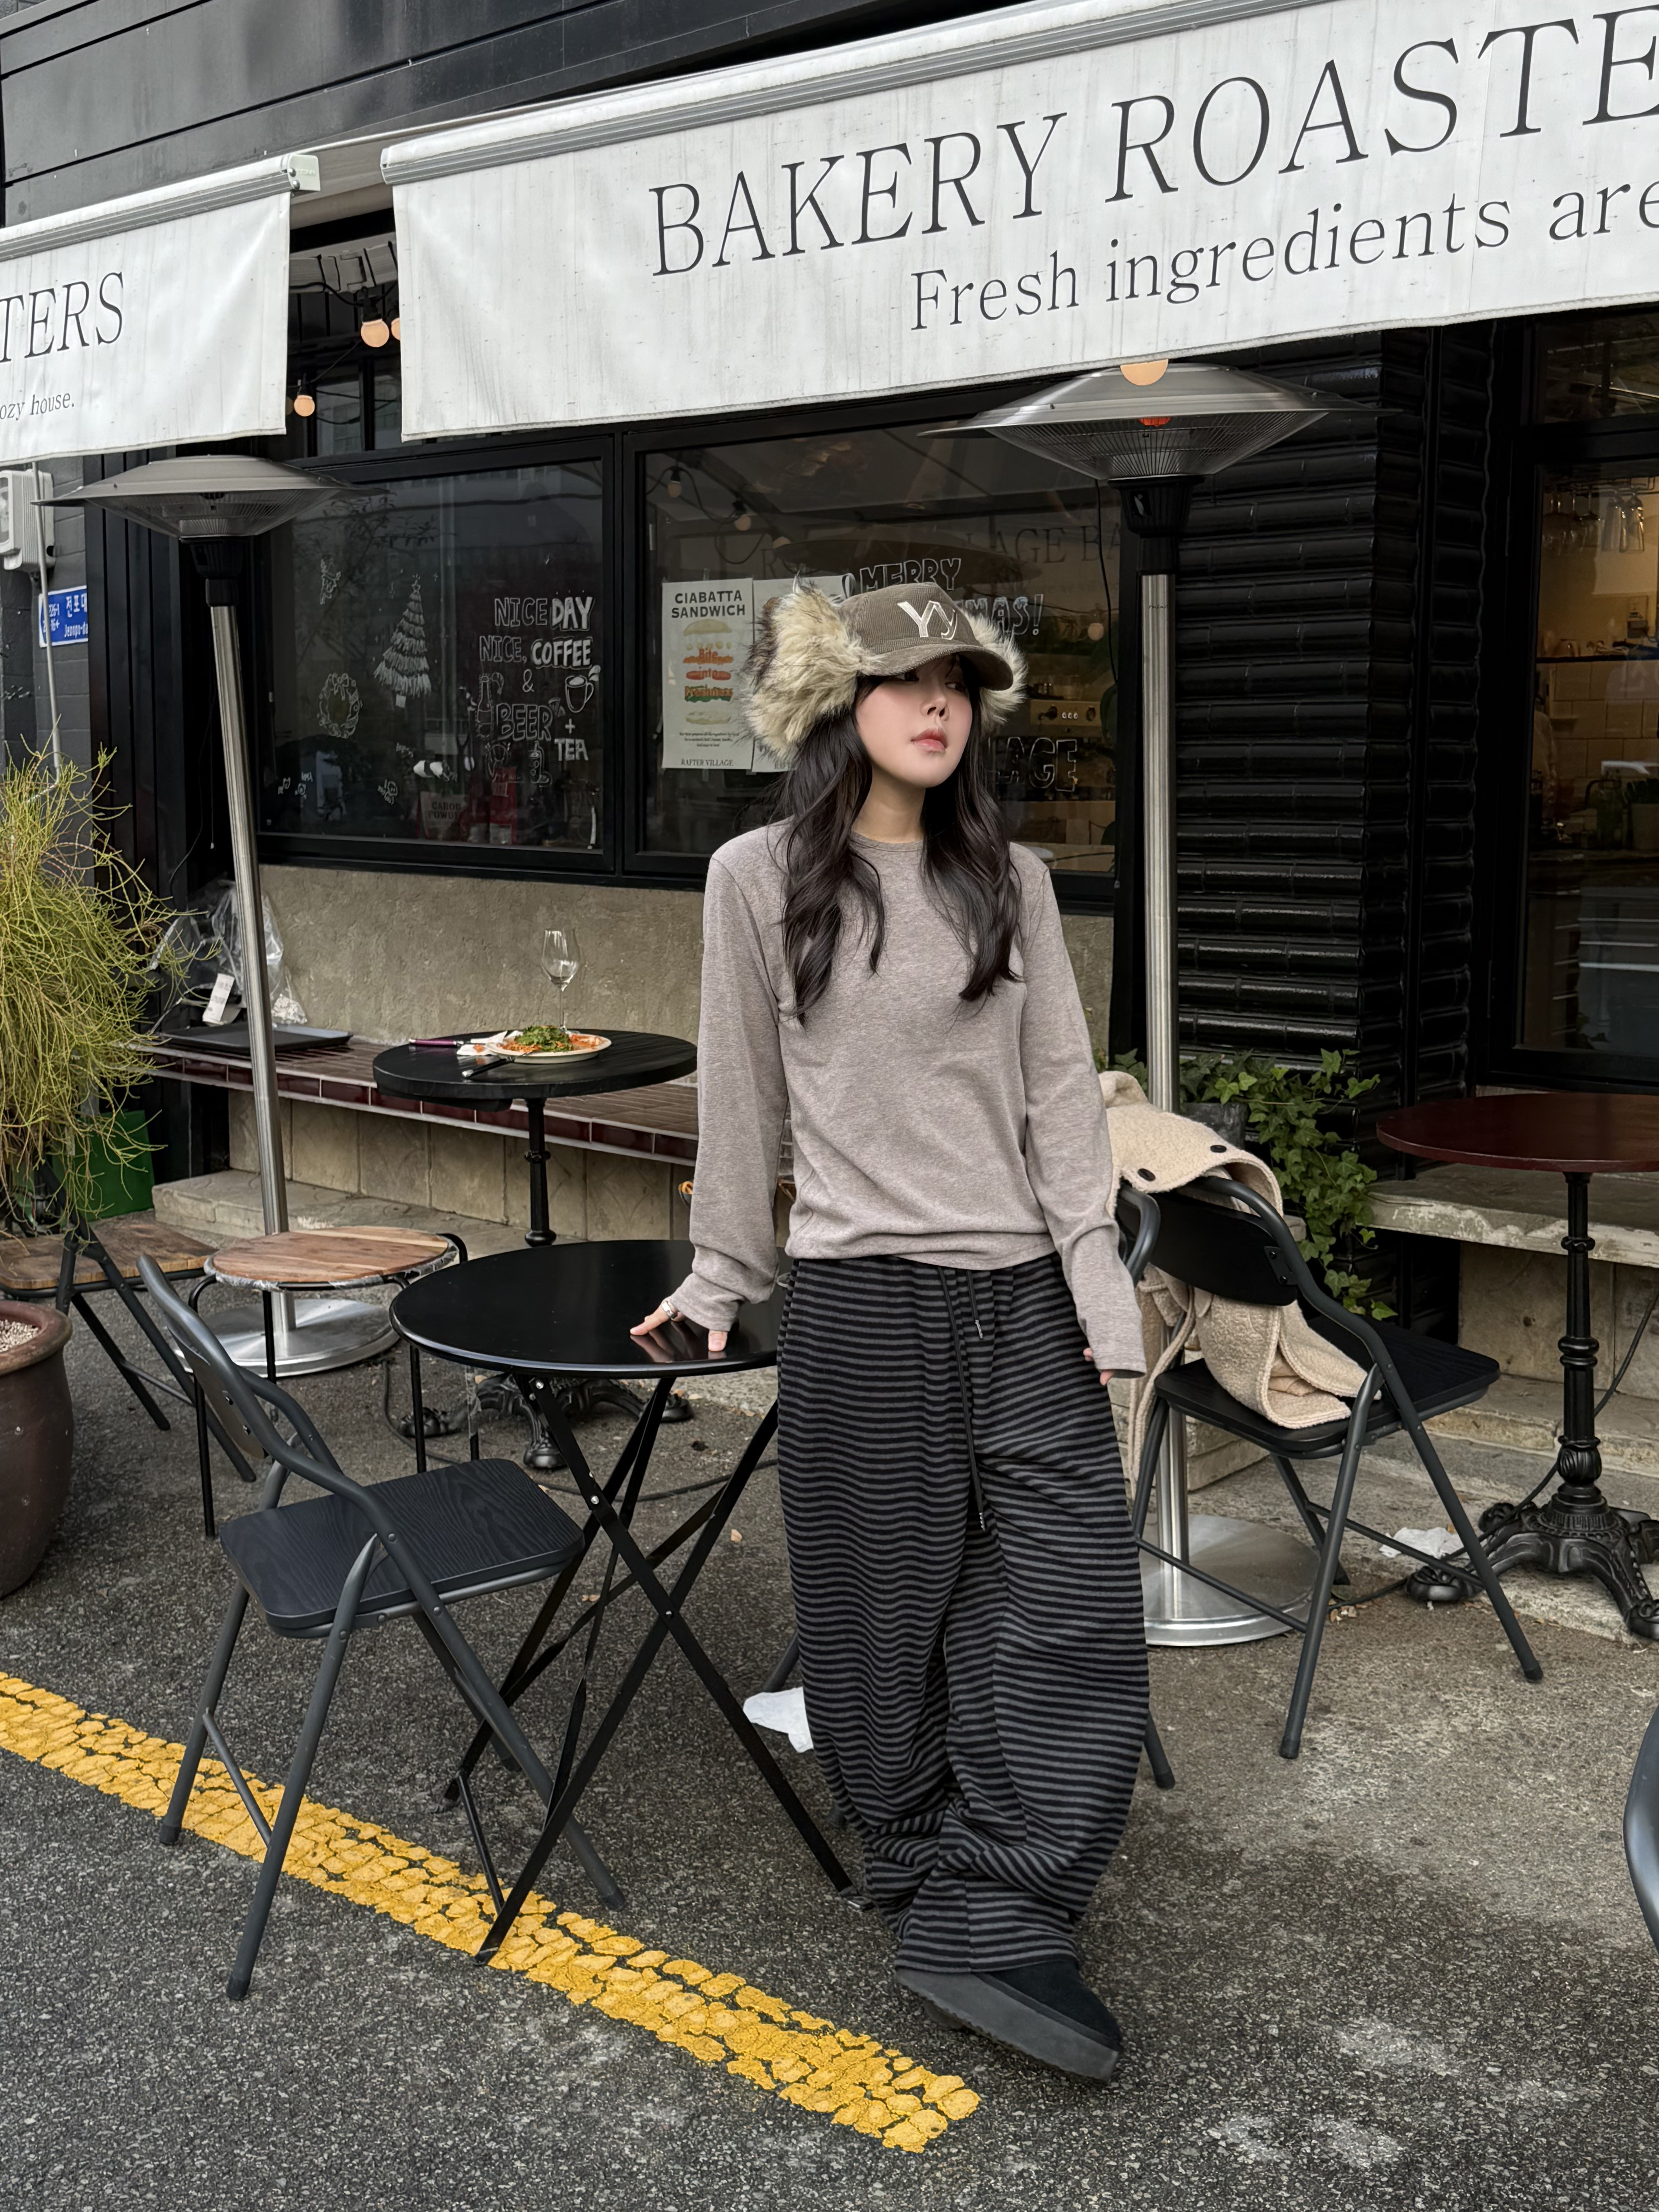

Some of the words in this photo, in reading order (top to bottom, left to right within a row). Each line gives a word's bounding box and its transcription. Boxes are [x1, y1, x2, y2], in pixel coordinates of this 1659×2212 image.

[649, 112, 1067, 276] BAKERY
[1105, 5, 1659, 204] ROASTE
[911, 250, 1079, 331] Fresh
[1105, 193, 1510, 305] ingredients
[1548, 180, 1659, 242] are
[30, 392, 75, 416] house.
[859, 558, 961, 591] MERRY
[495, 598, 548, 627] NICE
[552, 596, 594, 630] DAY
[671, 604, 745, 618] SANDWICH
[674, 590, 742, 604] CIABATTA
[956, 594, 1043, 636] MAS!
[532, 638, 592, 667] COFFEE
[522, 669, 534, 692] &
[495, 703, 553, 741] BEER
[554, 738, 588, 761] TEA
[988, 737, 1078, 792] AGE
